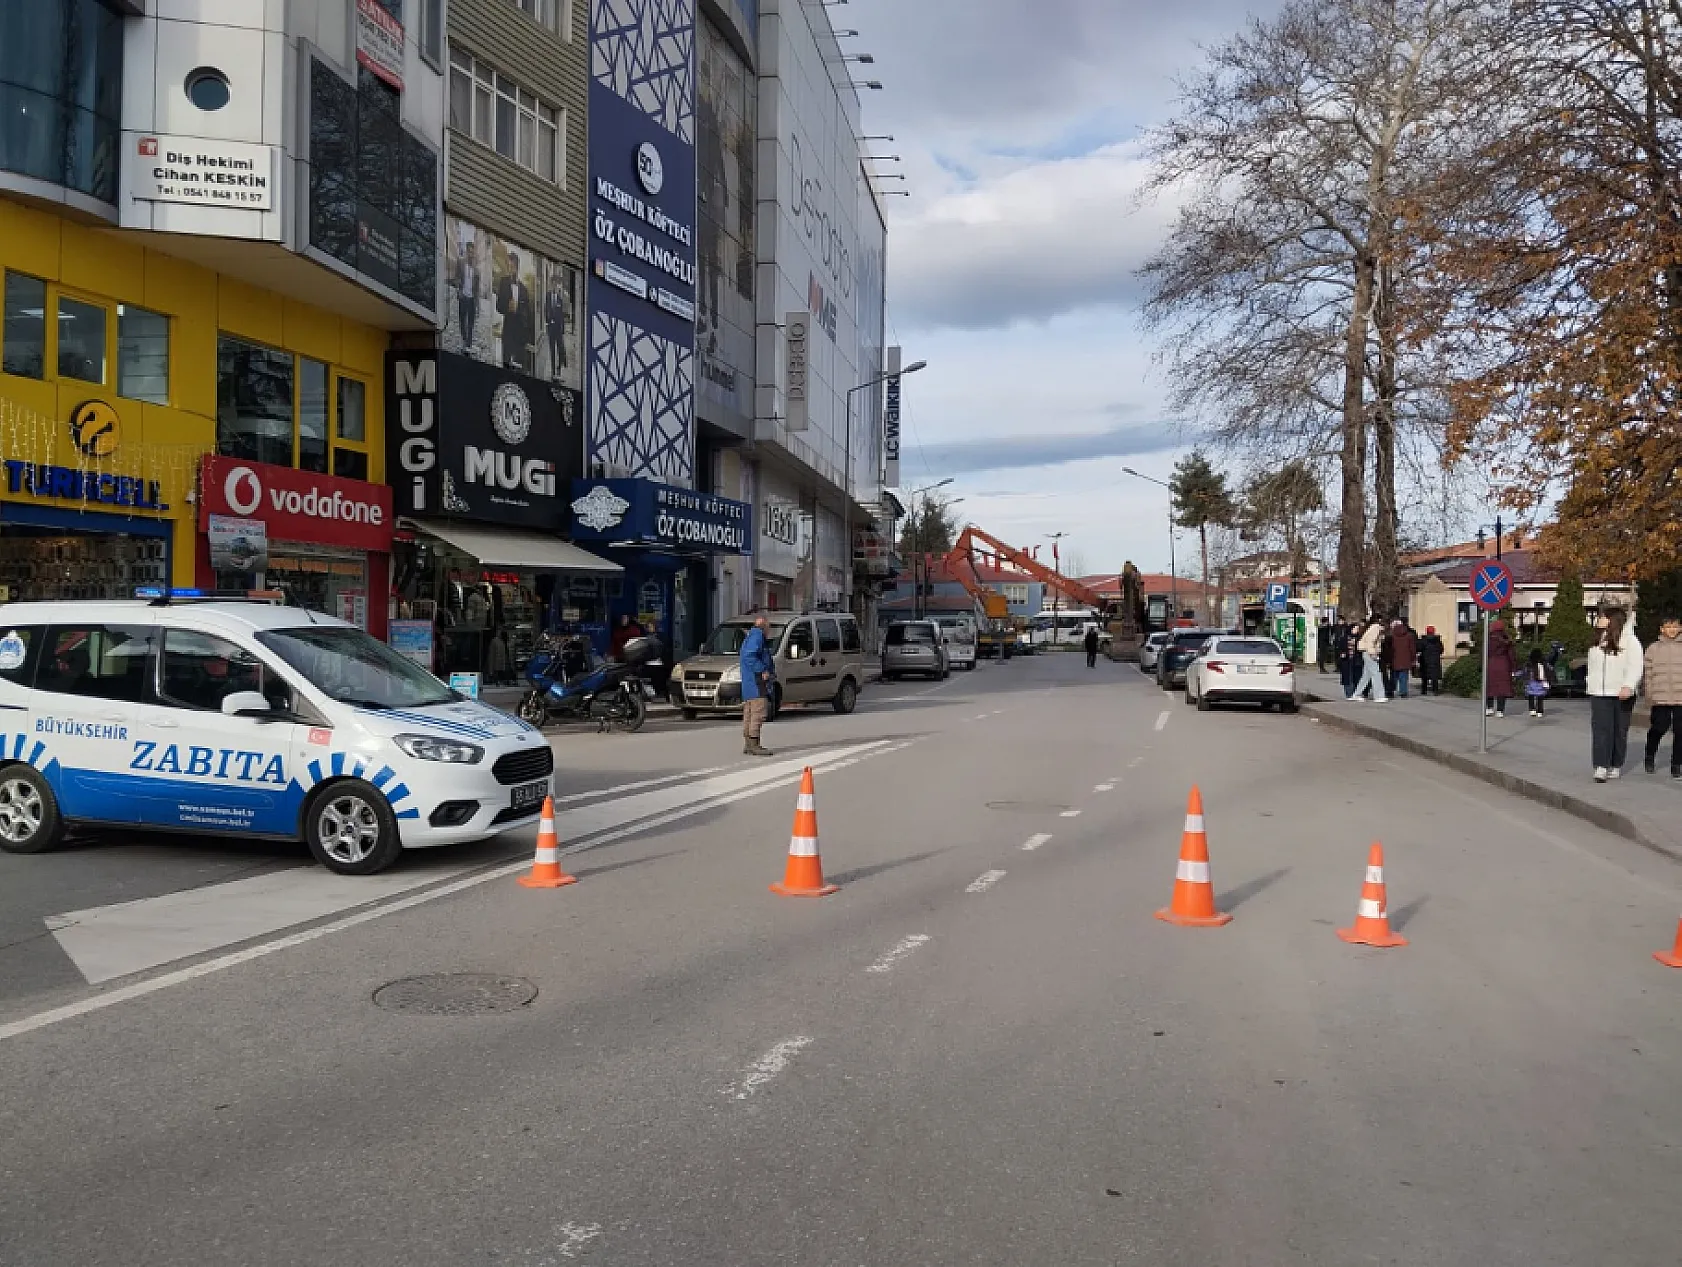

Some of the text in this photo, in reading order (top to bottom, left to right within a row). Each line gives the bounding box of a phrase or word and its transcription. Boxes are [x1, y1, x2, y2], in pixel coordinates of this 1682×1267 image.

[153, 167, 266, 188] Cihan KESKİN
[166, 151, 253, 171] Diş Hekimi
[595, 208, 615, 244] ÖZ
[617, 226, 695, 286] ÇOBANOĞLU
[5, 459, 170, 511] TURKCELL
[657, 489, 700, 511] MEŞHUR
[269, 486, 384, 524] vodafone
[657, 508, 674, 537] ÖZ
[677, 518, 745, 548] ÇOBANOĞLU
[129, 740, 287, 785] ZABITA
